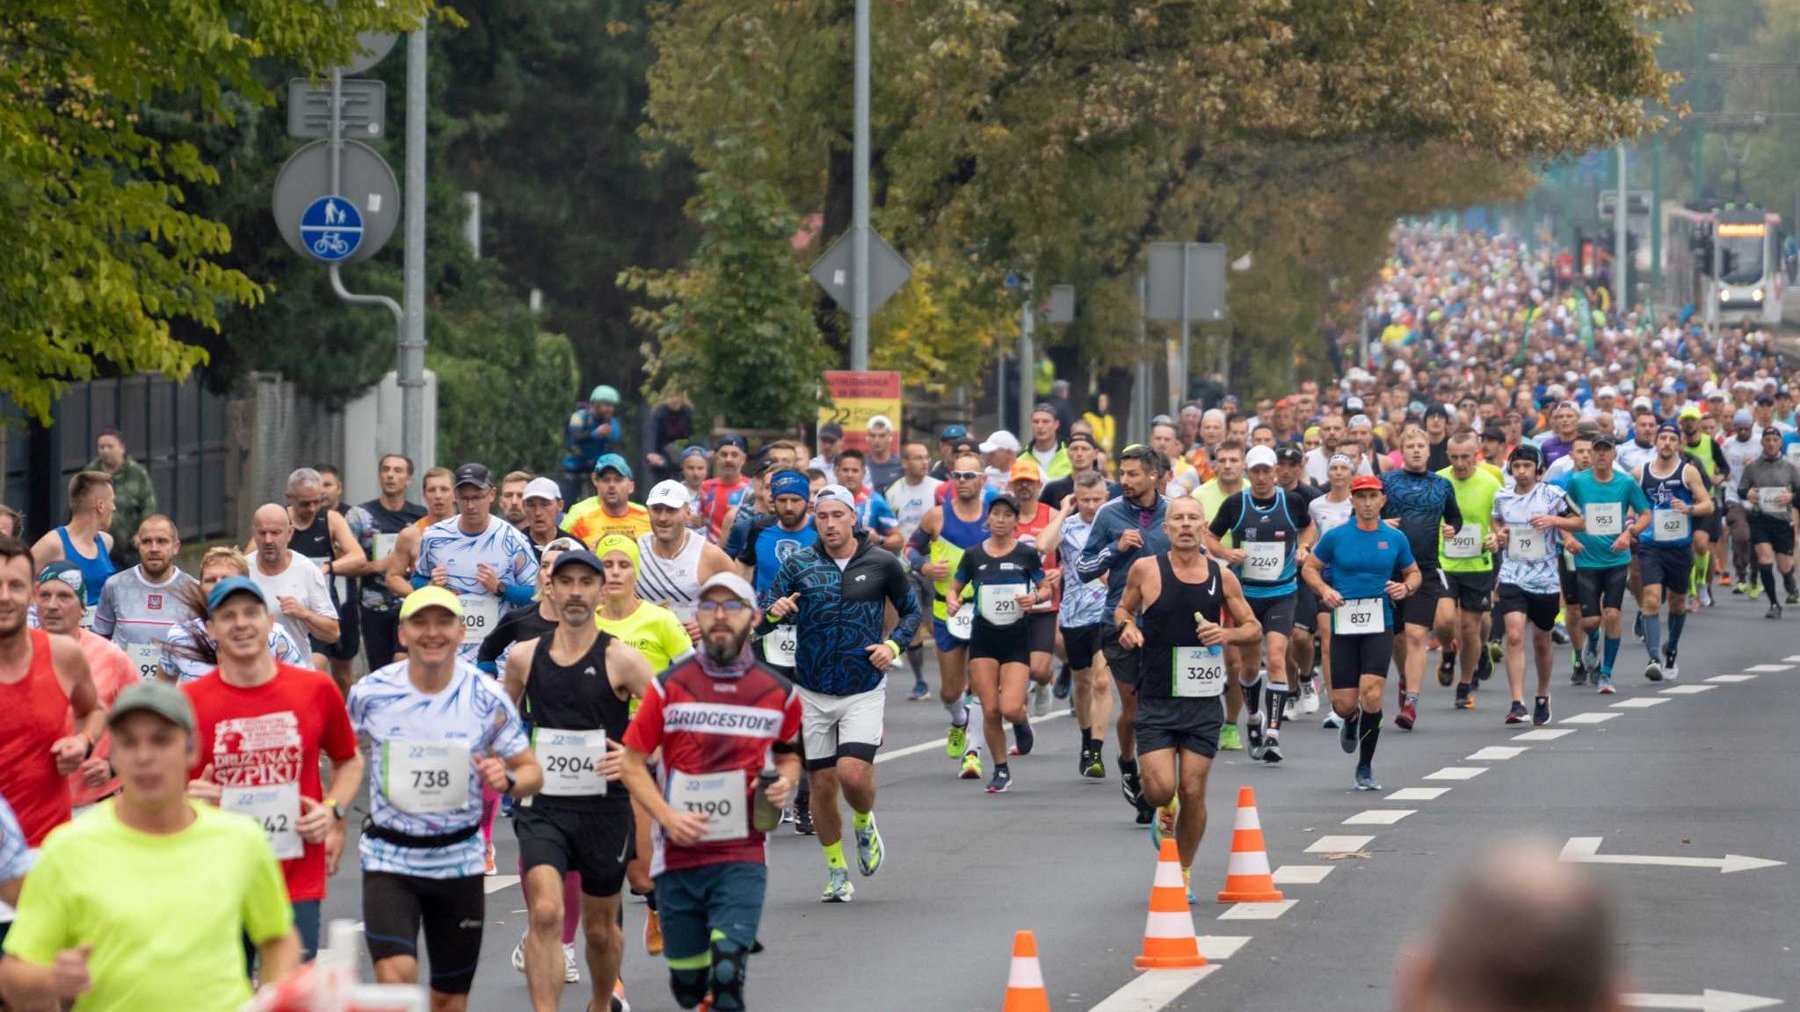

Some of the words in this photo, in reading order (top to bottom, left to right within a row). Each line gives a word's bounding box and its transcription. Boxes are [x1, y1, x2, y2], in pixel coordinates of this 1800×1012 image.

[829, 407, 850, 425] 22
[1596, 515, 1613, 524] 953
[1664, 521, 1680, 530] 622
[1519, 539, 1532, 548] 79
[1250, 556, 1279, 567] 2249
[994, 600, 1015, 612] 291
[1350, 612, 1371, 624] 837
[1187, 665, 1222, 680] 3260
[546, 755, 594, 773] 2904
[215, 762, 303, 786] SZPIKU
[410, 769, 451, 789] 738
[254, 813, 289, 833] 42
